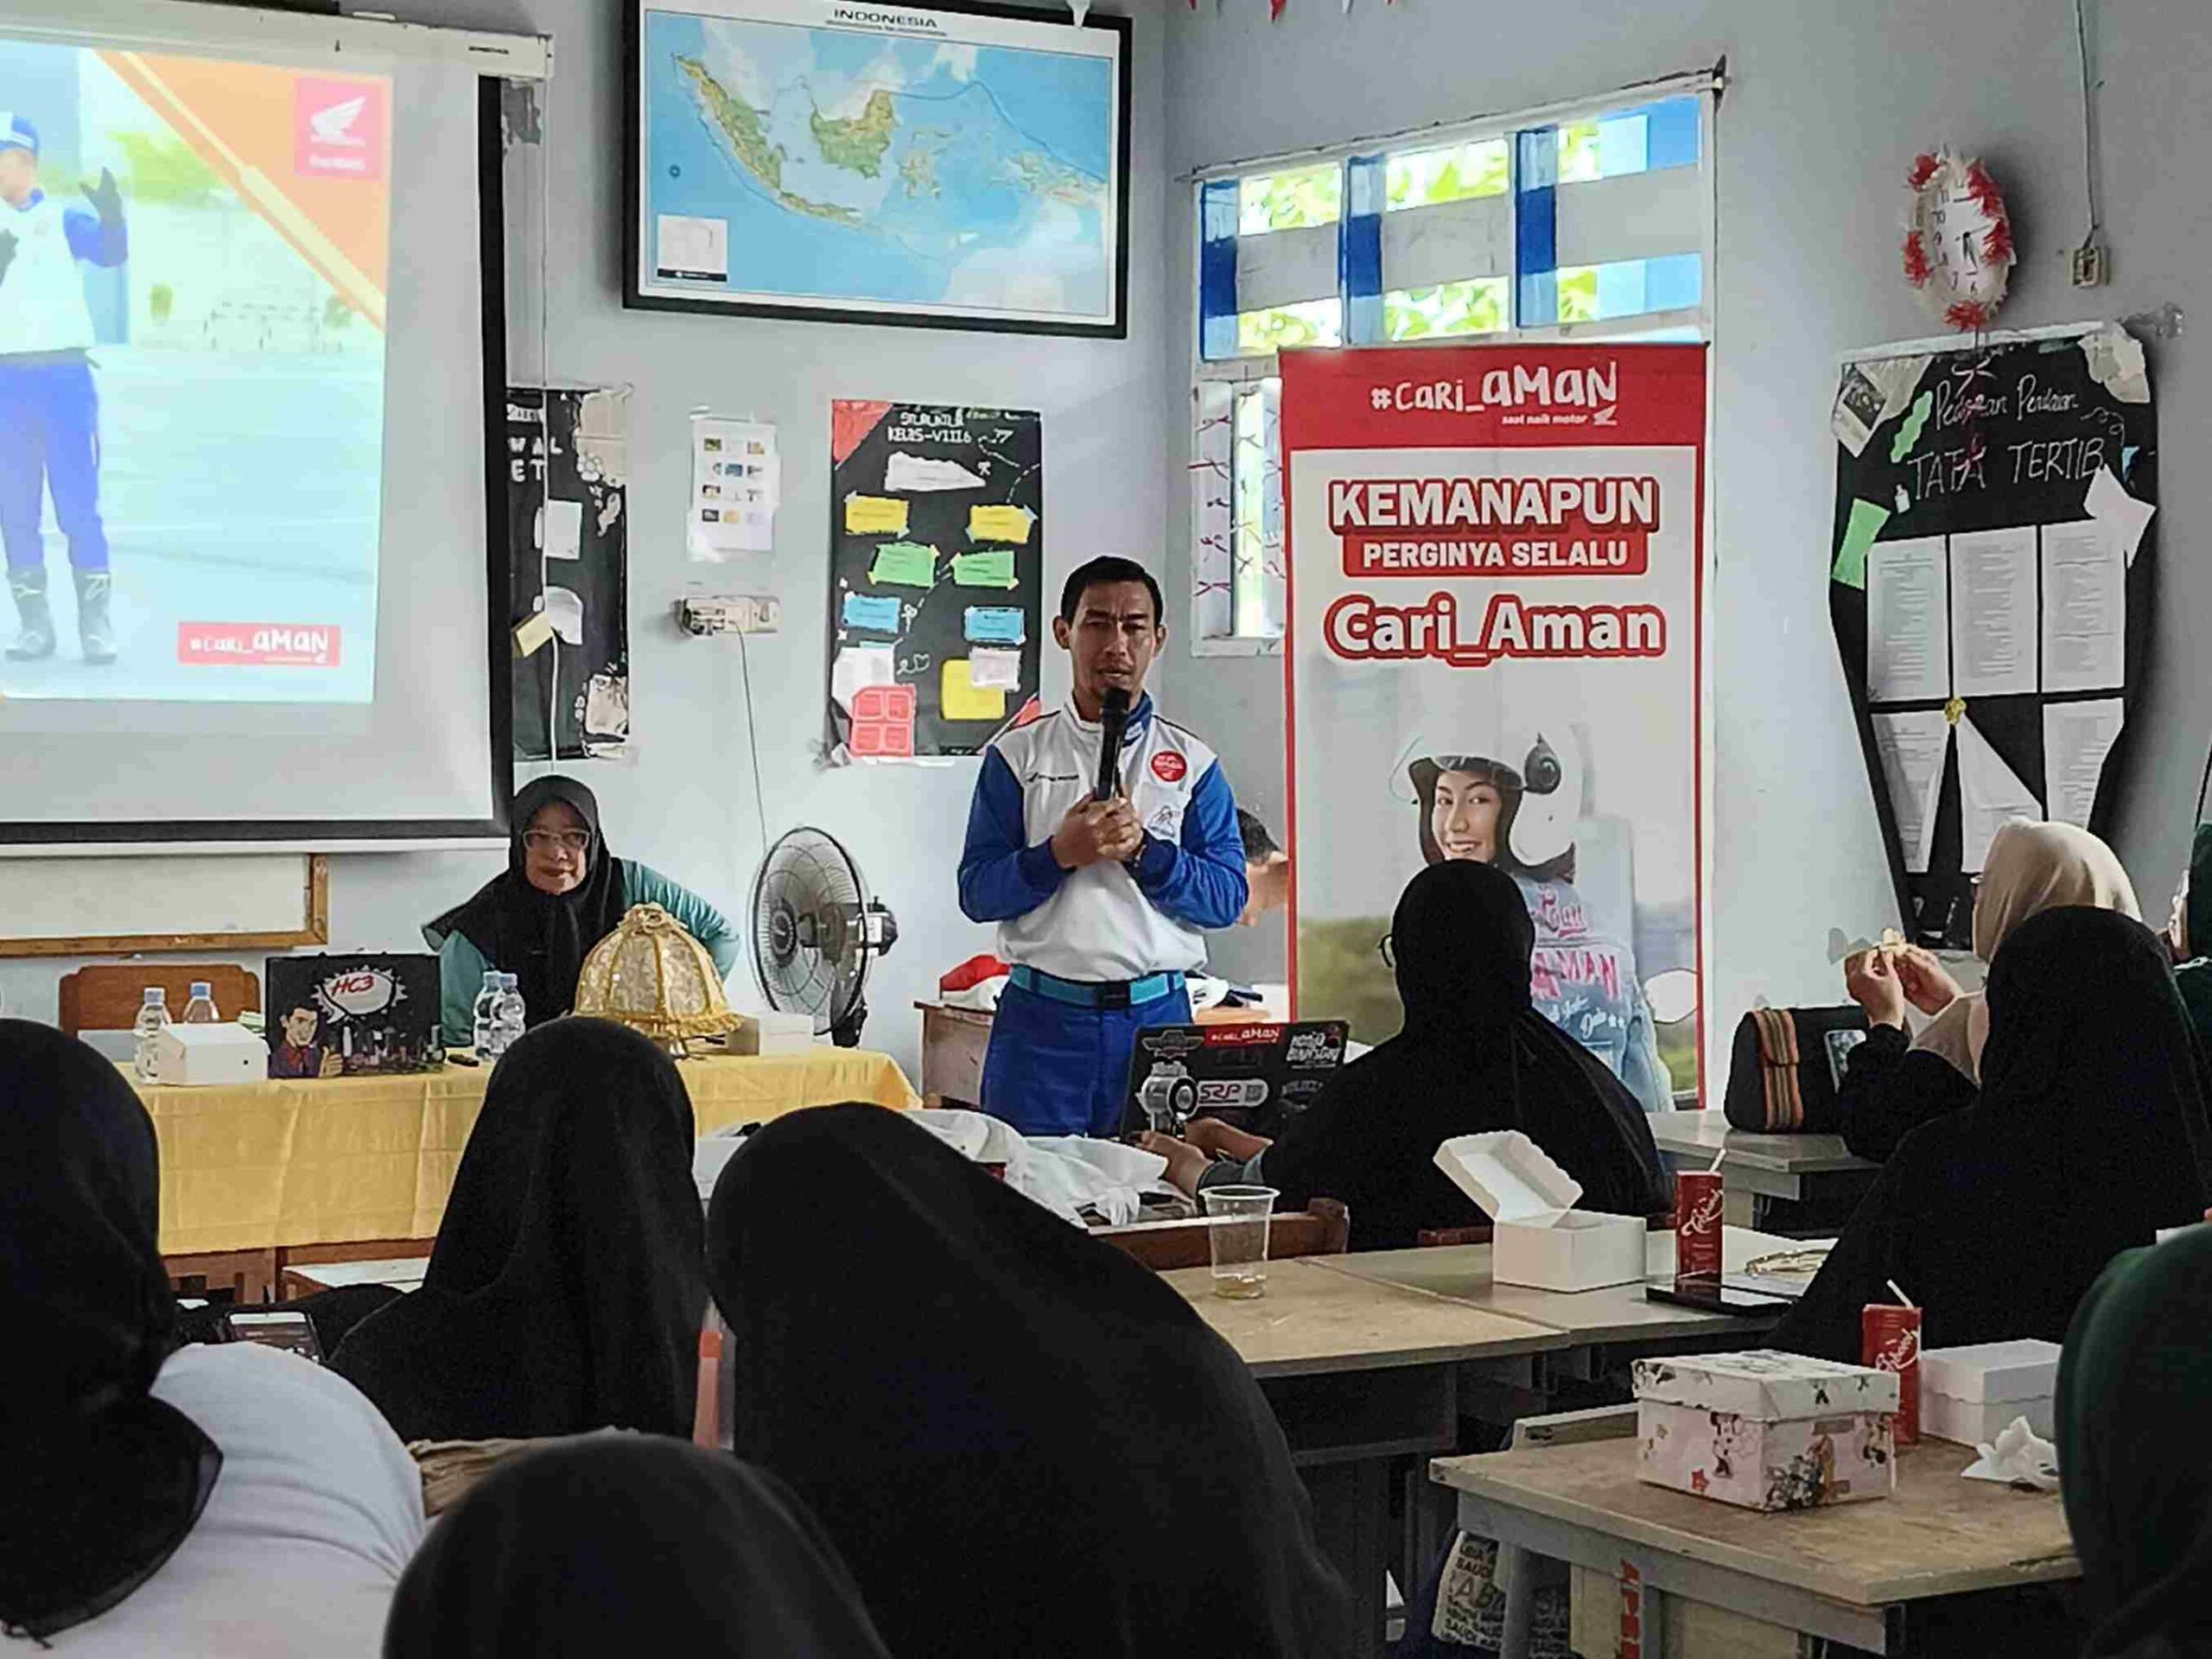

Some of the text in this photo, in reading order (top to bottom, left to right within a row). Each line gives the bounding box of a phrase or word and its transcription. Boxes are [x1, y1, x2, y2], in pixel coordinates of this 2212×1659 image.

[834, 10, 938, 28] INDONESIA
[1553, 414, 1588, 424] motor
[1907, 437, 2105, 500] TATA TERTIB
[1332, 480, 1654, 527] KEMANAPUN
[1363, 541, 1628, 569] PERGINYA SELALU
[1333, 599, 1662, 659] Cari_Aman
[331, 974, 374, 995] HC3
[1200, 1084, 1243, 1101] SRP
